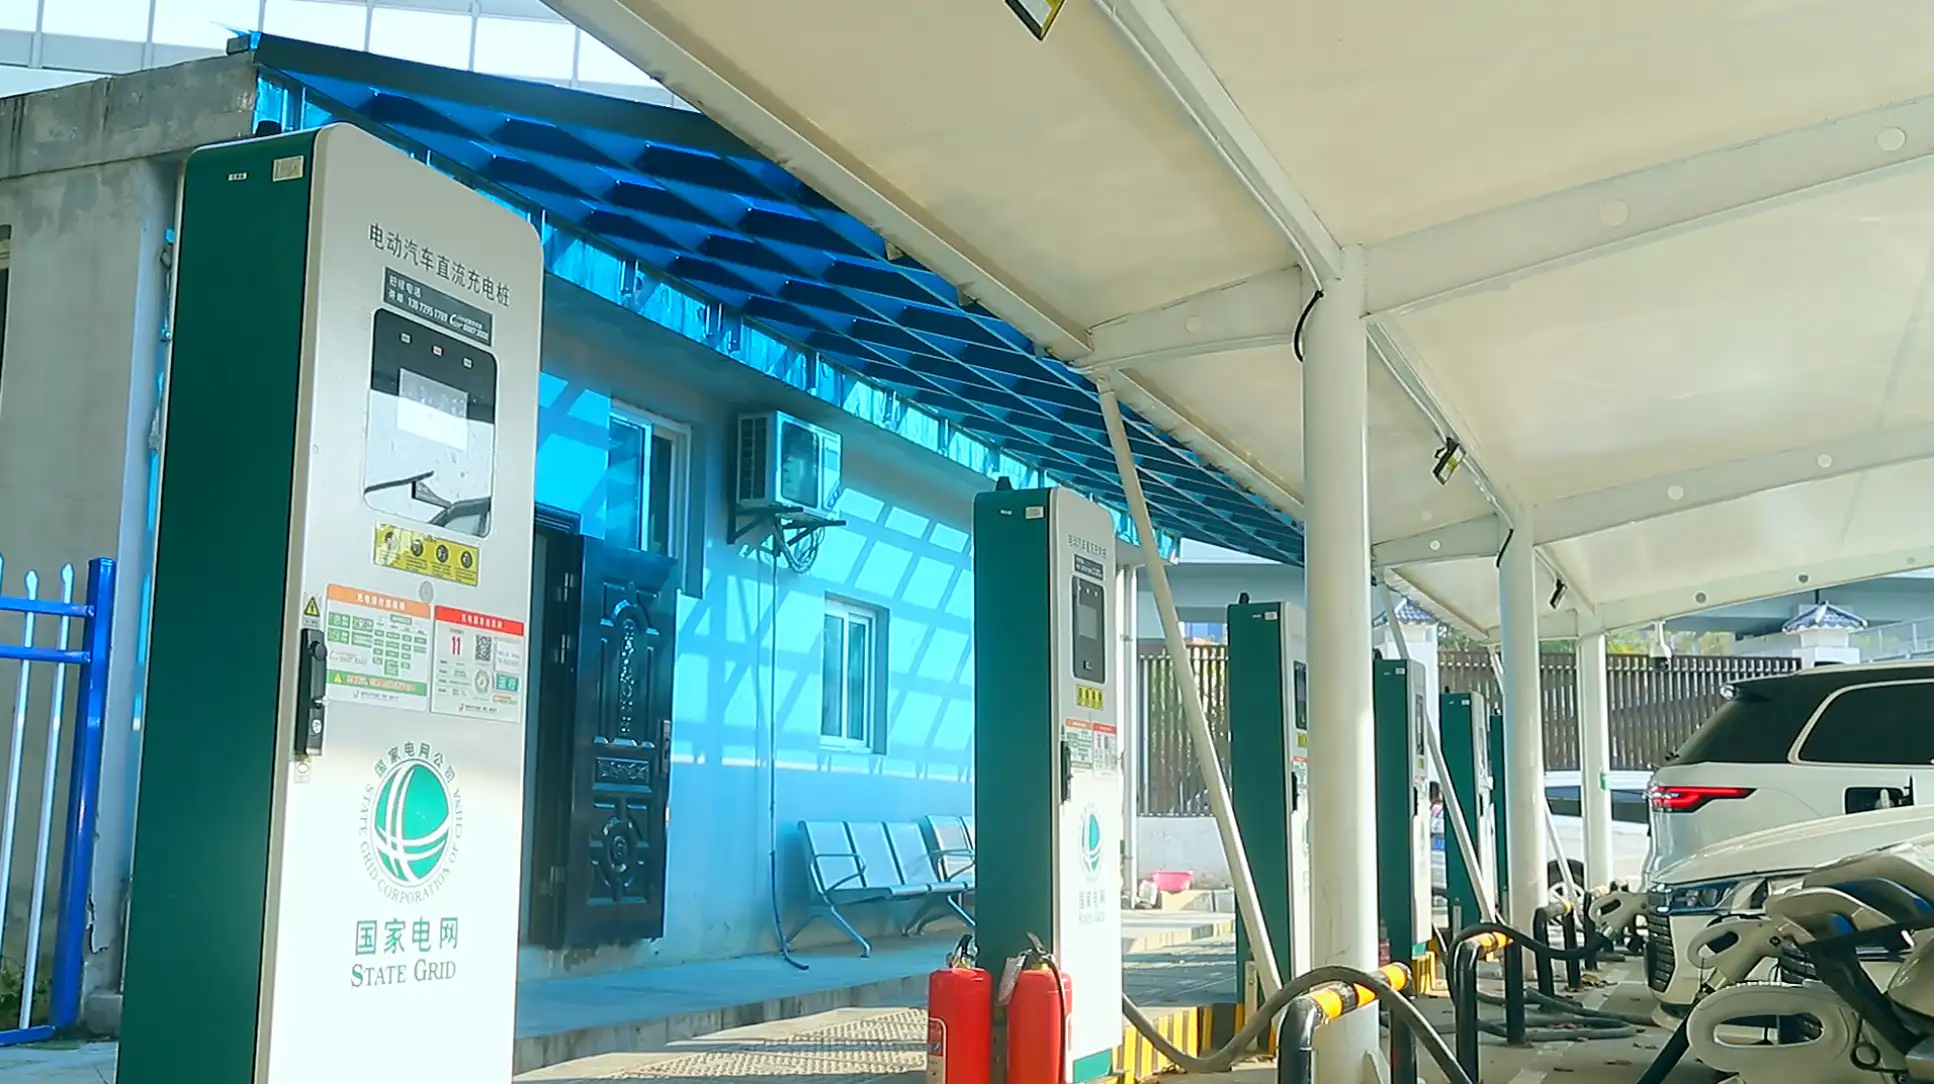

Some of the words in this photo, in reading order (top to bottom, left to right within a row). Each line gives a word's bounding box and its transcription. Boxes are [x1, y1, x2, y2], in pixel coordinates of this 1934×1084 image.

[369, 223, 510, 307] 电动汽车直流充电桩
[452, 636, 461, 656] 11
[355, 916, 459, 956] 国家电网
[350, 963, 407, 988] STATE
[413, 958, 457, 982] GRID
